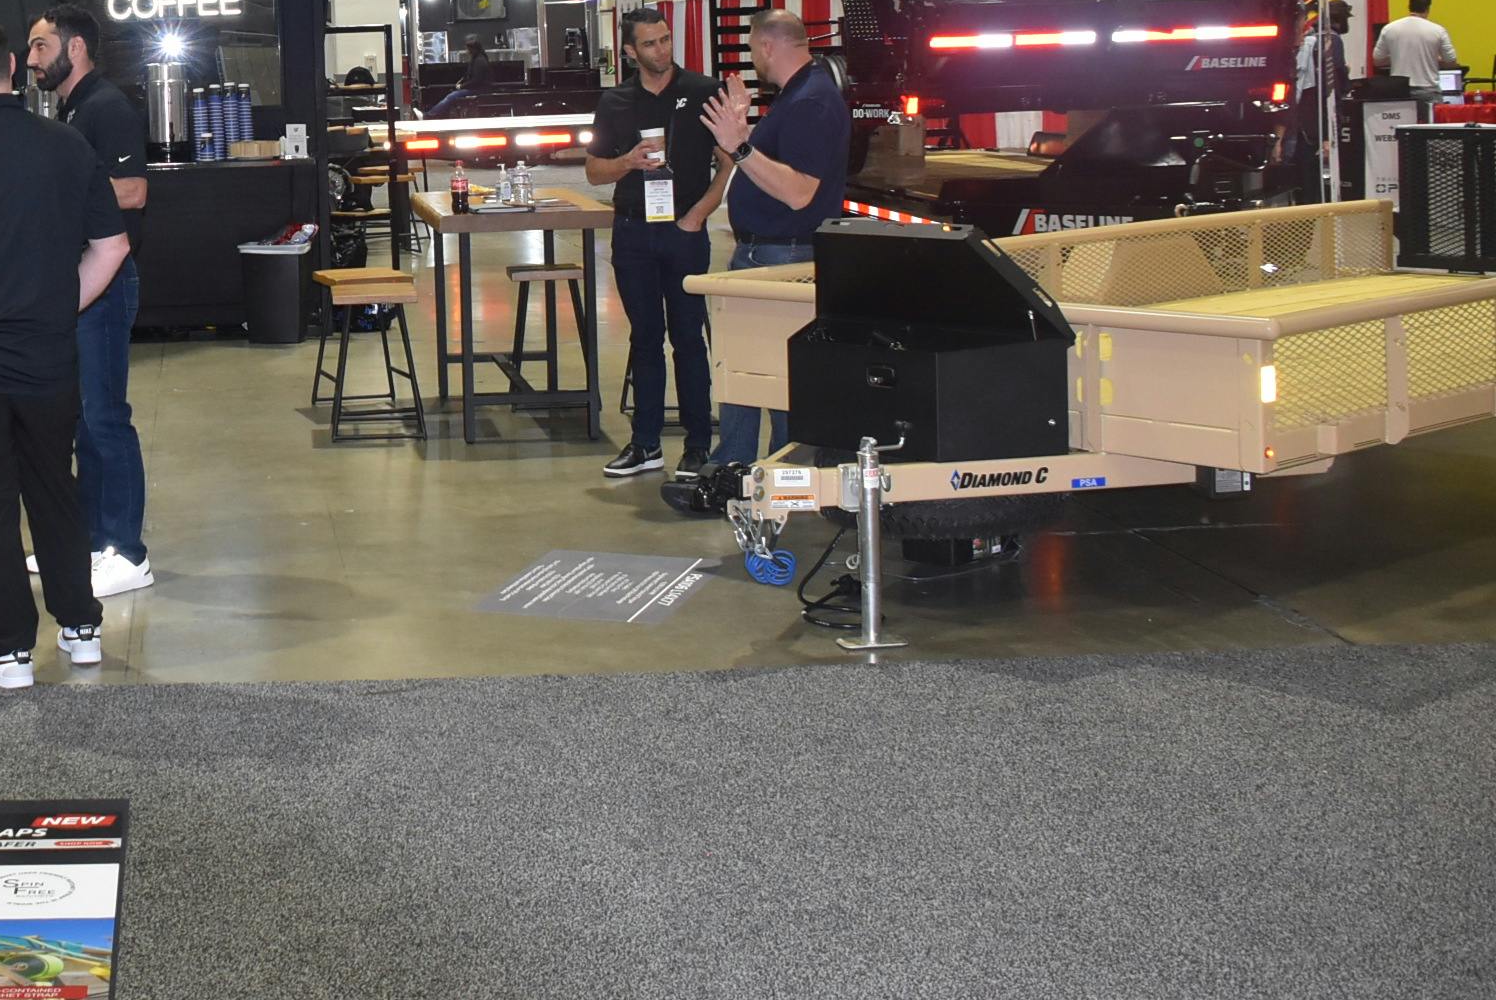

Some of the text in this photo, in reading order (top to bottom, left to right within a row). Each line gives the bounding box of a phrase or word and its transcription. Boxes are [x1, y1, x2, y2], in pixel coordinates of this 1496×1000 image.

[1200, 56, 1267, 69] BASELINE
[959, 466, 1049, 489] DIAMOND C
[1079, 478, 1097, 487] PSA
[39, 815, 106, 827] NEW
[2, 878, 45, 888] SPIN
[13, 887, 56, 896] FREE
